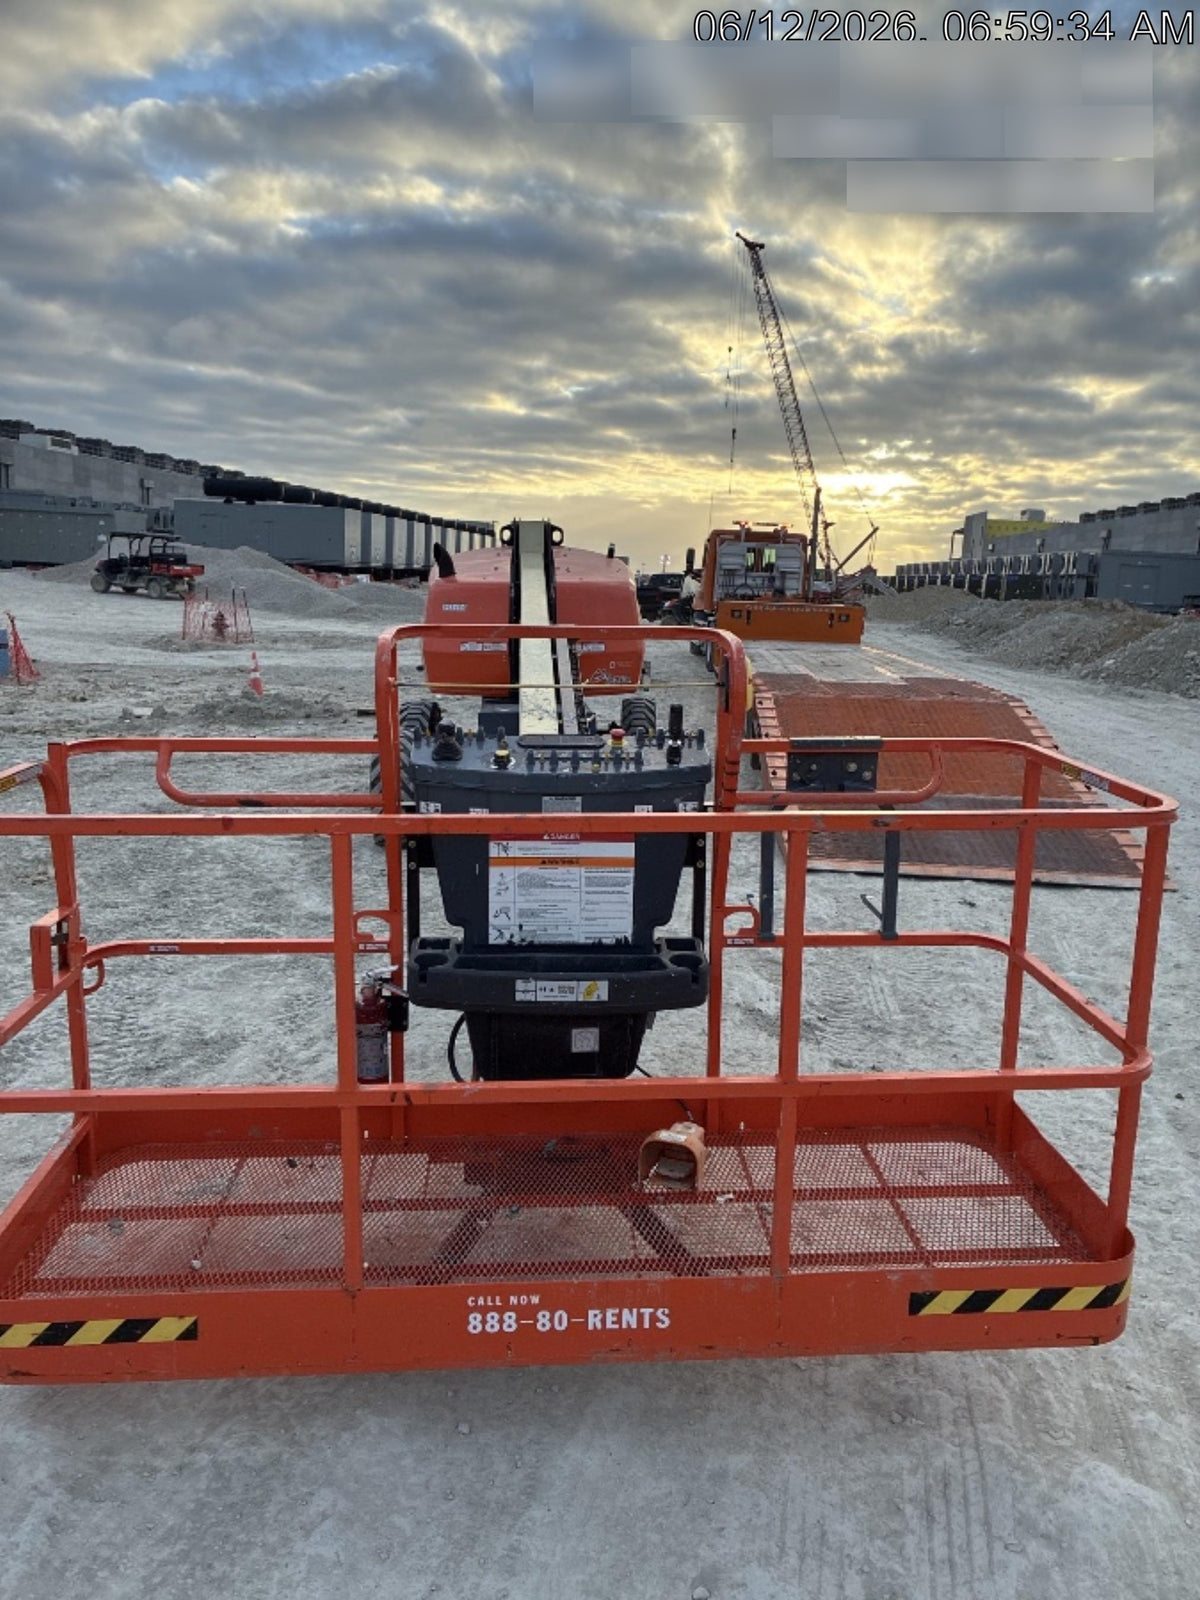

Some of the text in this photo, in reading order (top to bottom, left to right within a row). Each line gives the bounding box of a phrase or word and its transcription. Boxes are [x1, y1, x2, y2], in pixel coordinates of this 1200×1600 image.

[467, 1294, 540, 1307] CALL NOW
[467, 1307, 671, 1334] 888-80-RENTS
